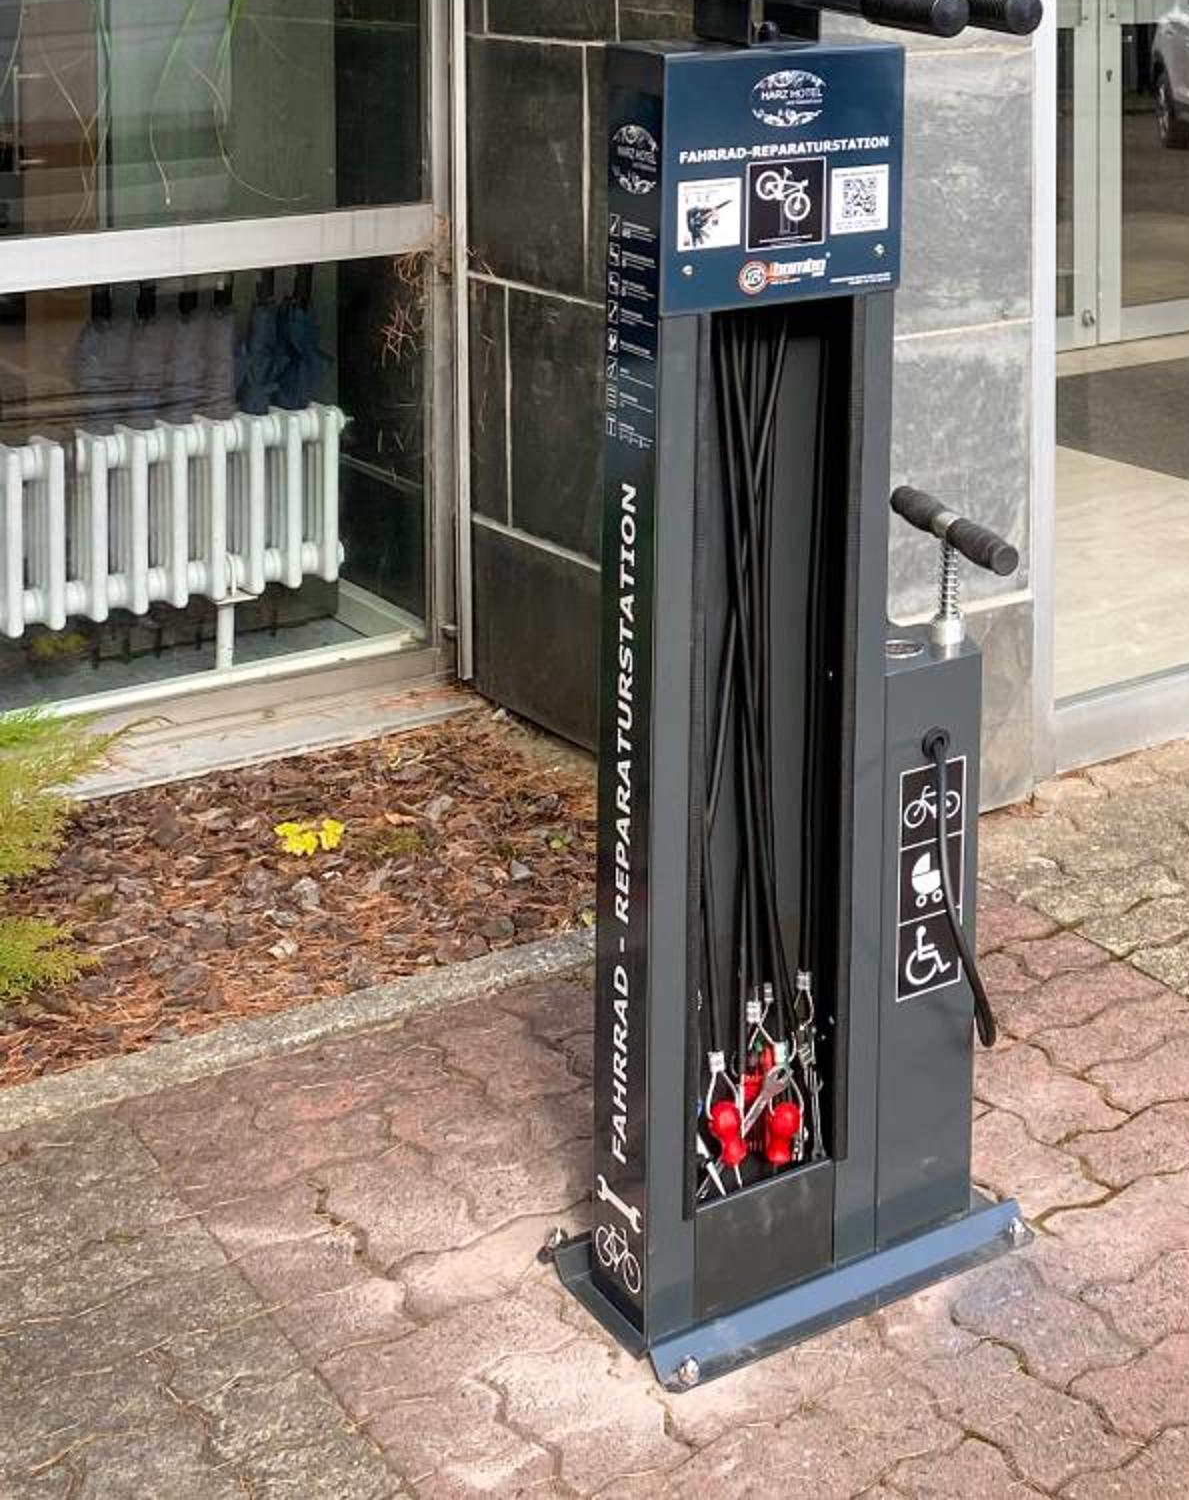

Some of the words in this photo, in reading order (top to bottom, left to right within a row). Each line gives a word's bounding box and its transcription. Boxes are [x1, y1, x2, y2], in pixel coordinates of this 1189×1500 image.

[678, 135, 890, 165] FAHRRAD-REPARATURSTATION
[761, 89, 788, 100] HARZ
[790, 87, 823, 100] HOTEL
[613, 482, 638, 925] REPARATURSTATION
[611, 963, 630, 1165] FAHRRAD
